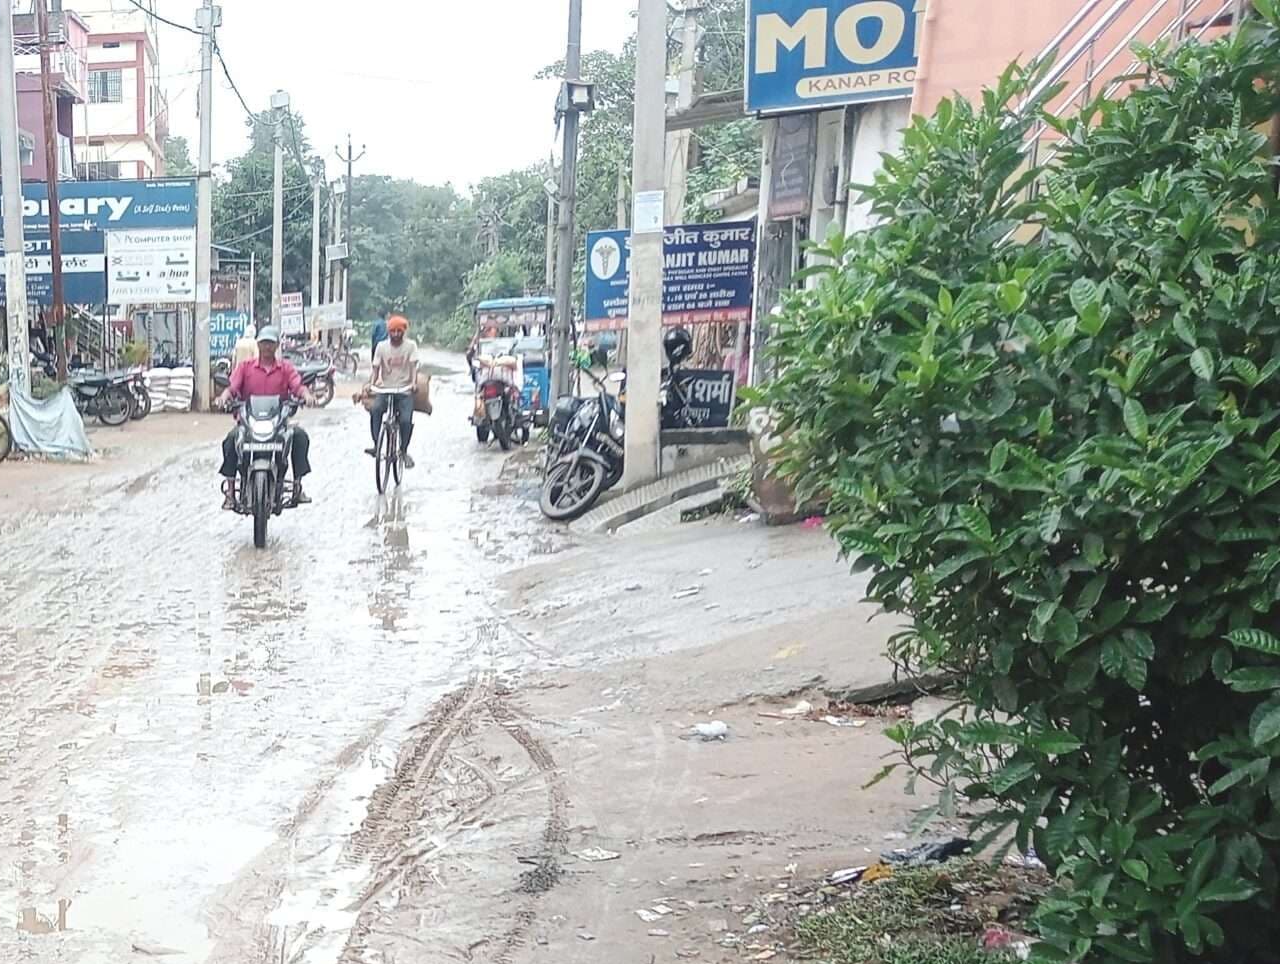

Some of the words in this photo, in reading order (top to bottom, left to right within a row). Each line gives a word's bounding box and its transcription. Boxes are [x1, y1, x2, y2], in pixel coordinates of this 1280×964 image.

[808, 73, 881, 93] KANAP
[154, 202, 171, 214] Study
[663, 228, 698, 245] जीत
[703, 228, 751, 248] कुमार
[663, 251, 695, 269] ANJIT
[698, 249, 749, 267] KUMAR
[210, 312, 248, 331] जीवनी
[694, 374, 731, 404] शर्मा
